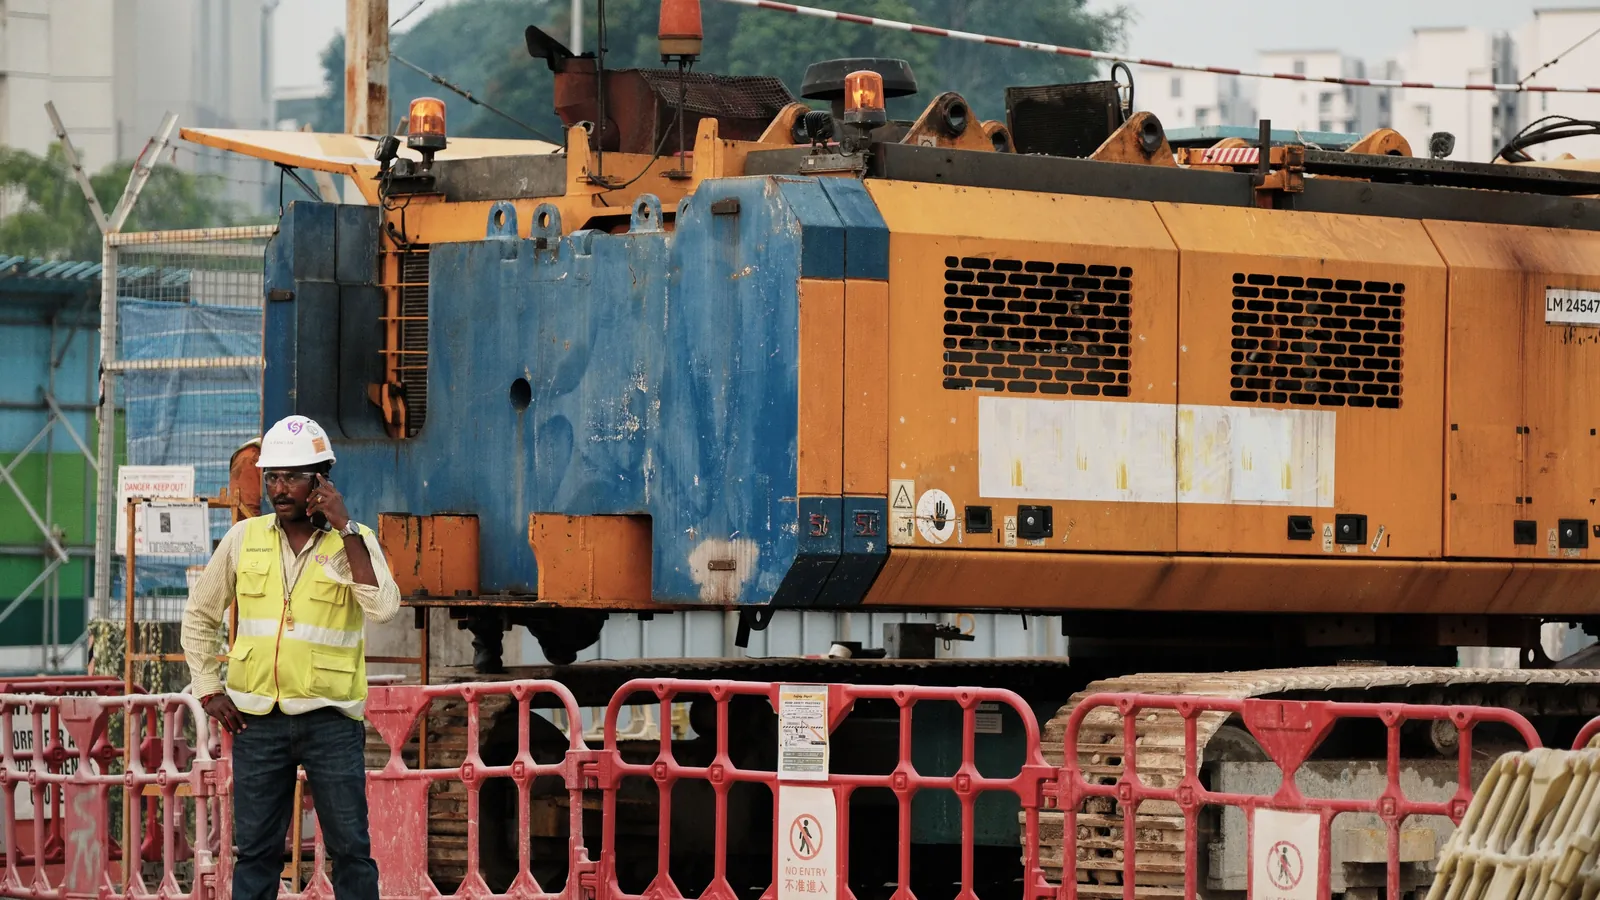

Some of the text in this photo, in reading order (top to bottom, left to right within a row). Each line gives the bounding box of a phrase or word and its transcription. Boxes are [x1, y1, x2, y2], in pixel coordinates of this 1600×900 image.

[1546, 298, 1563, 312] LM
[124, 483, 150, 492] DANGER
[153, 483, 170, 492] KEEP
[785, 866, 828, 877] NO ENTRY
